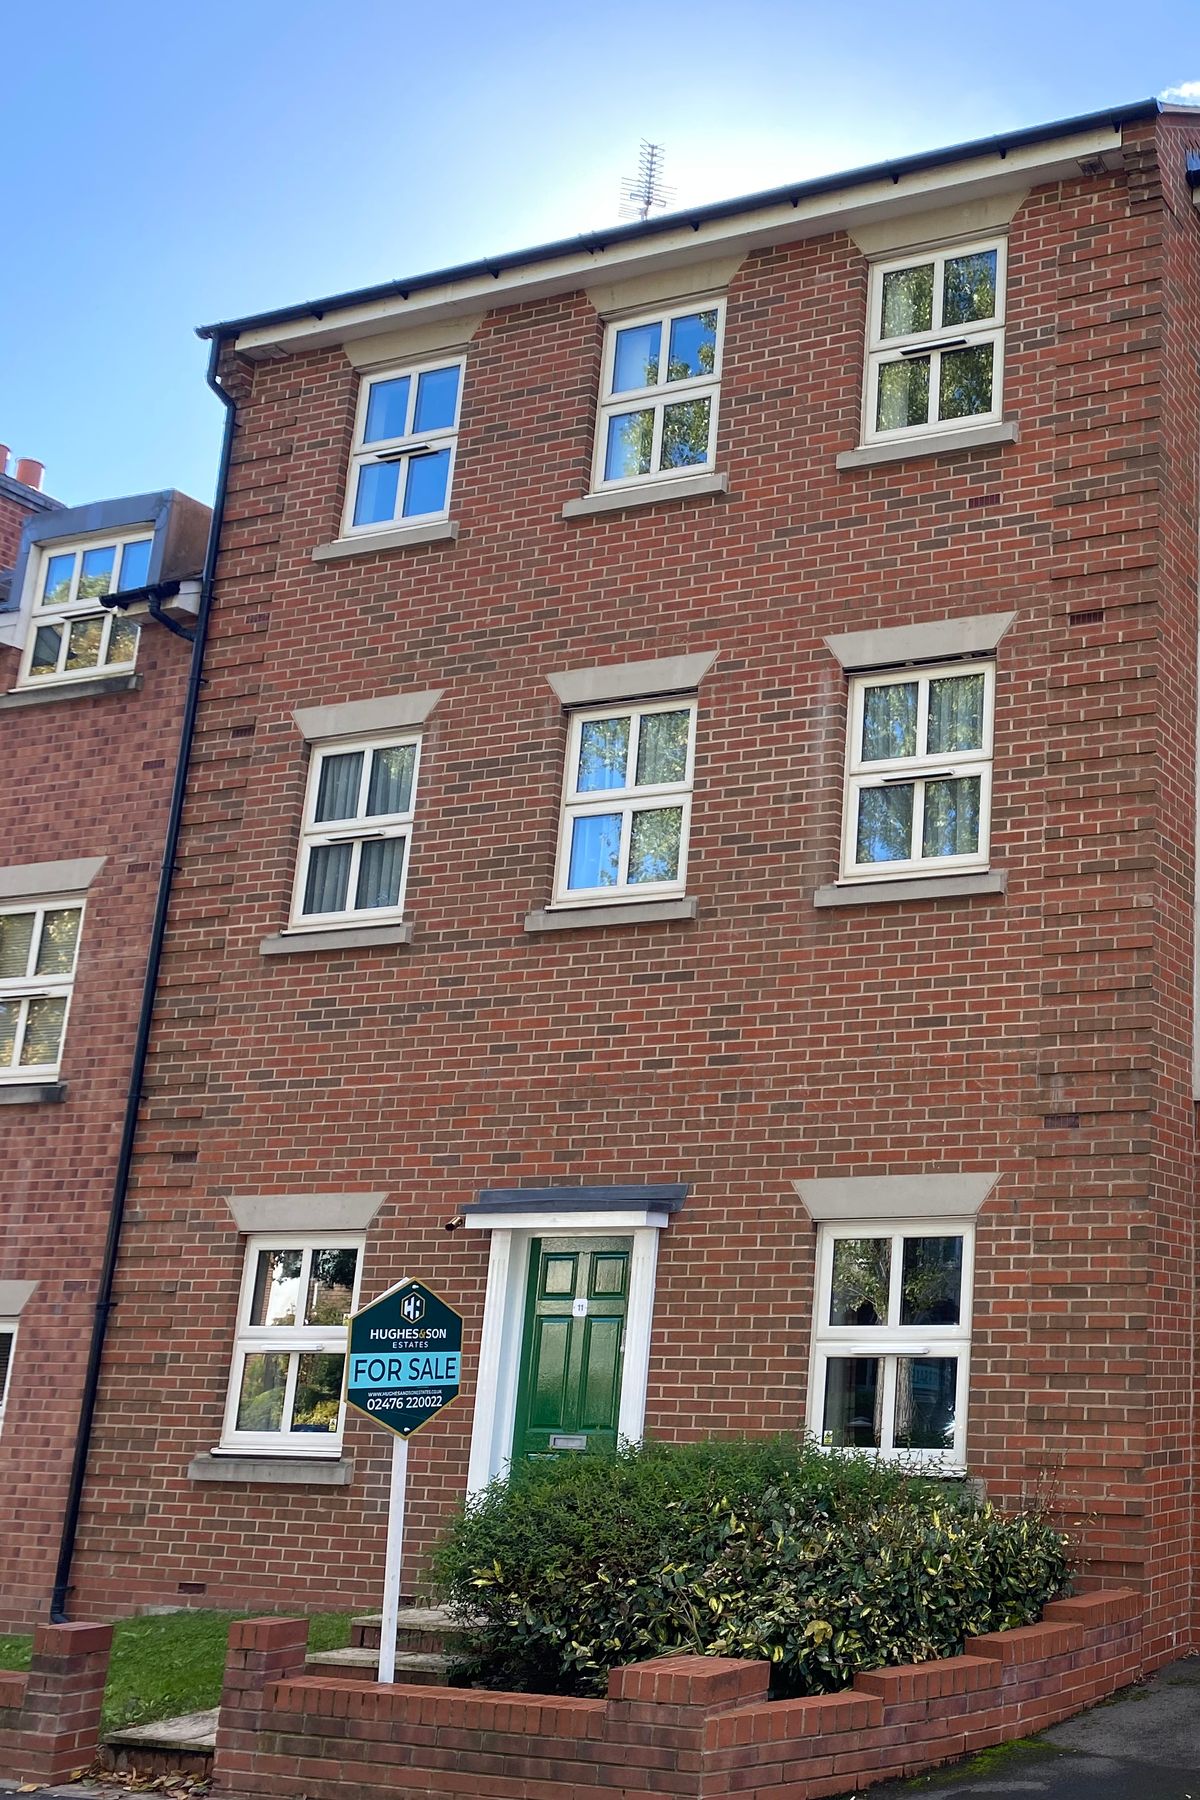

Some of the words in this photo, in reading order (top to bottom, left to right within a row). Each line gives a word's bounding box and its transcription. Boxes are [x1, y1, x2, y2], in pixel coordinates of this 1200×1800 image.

[370, 1328, 447, 1340] HUGHES&SON
[392, 1341, 429, 1349] ESTATES
[354, 1358, 402, 1382] FOR
[408, 1357, 457, 1381] SALE
[367, 1397, 404, 1410] 02476
[405, 1396, 443, 1409] 220022
